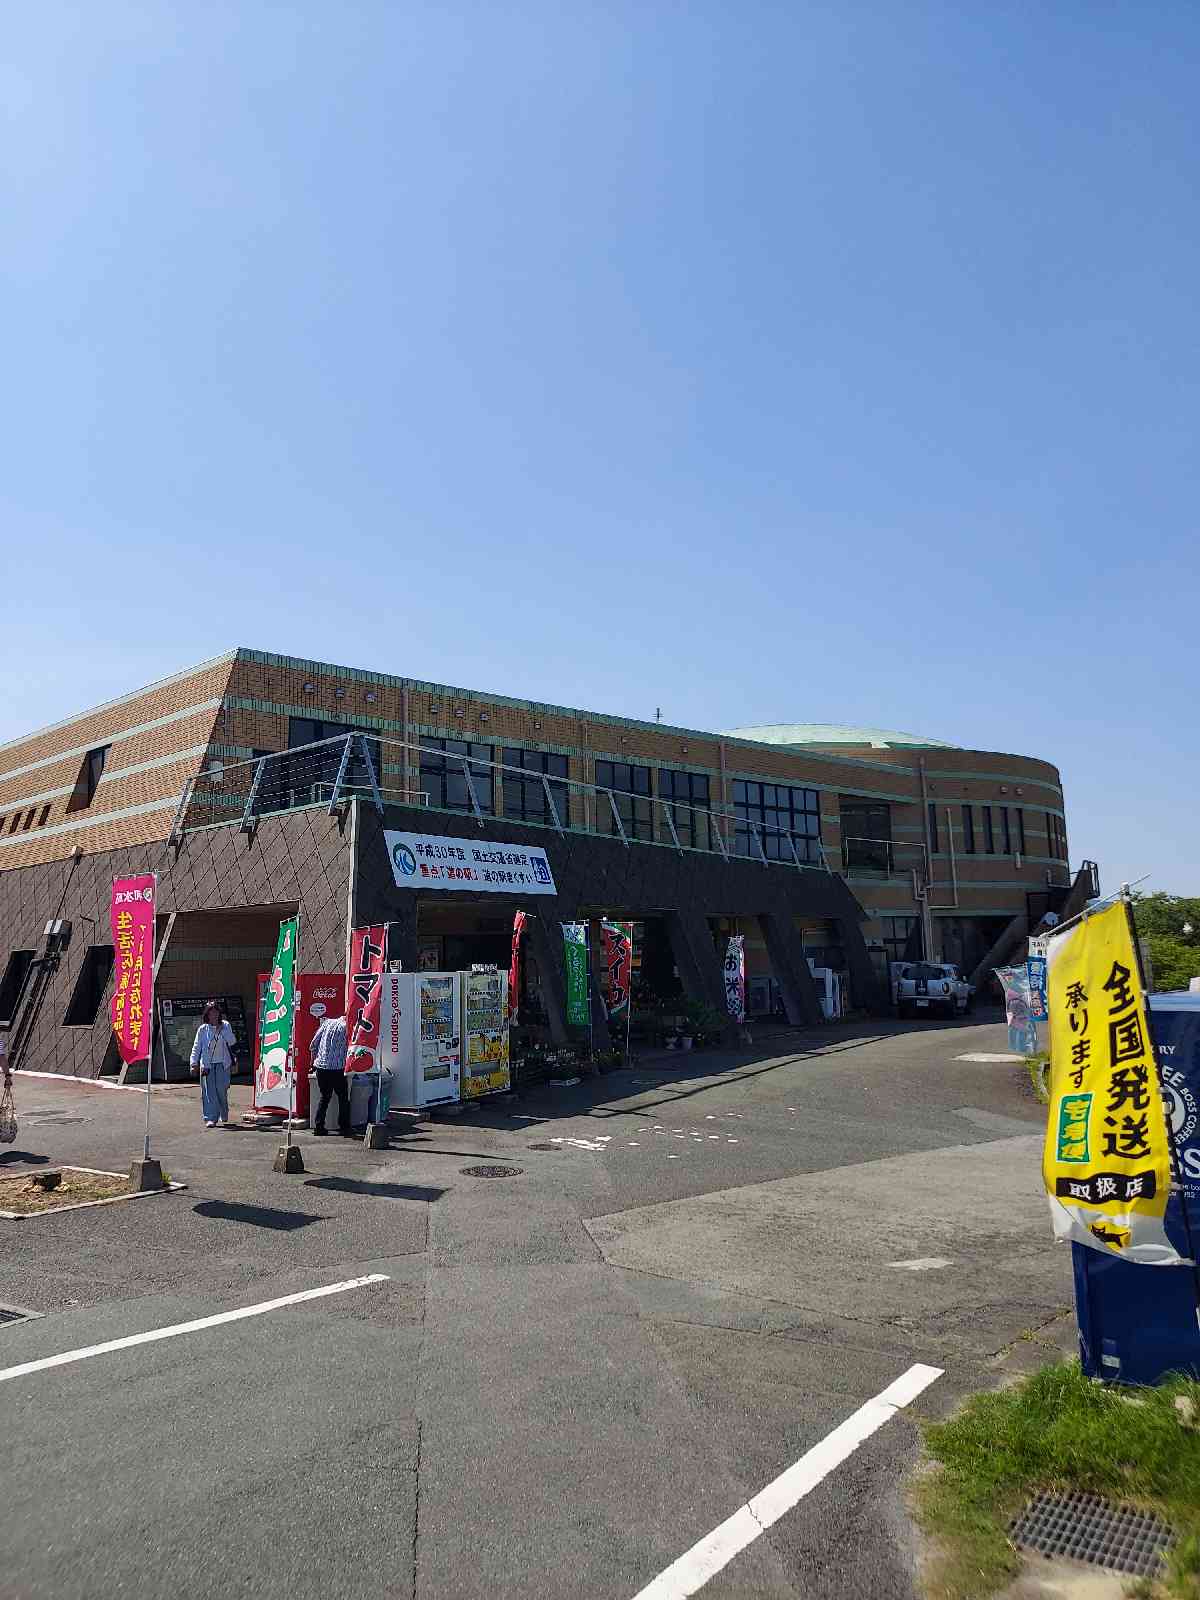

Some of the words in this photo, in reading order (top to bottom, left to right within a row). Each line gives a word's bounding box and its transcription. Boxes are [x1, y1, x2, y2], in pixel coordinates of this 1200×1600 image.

[415, 843, 466, 860] 平成30年度
[472, 849, 530, 866] 国土交通省選定
[351, 935, 383, 1045] トマト
[608, 932, 626, 1005] スイカ
[1065, 981, 1091, 1088] 承ります
[1101, 960, 1151, 1160] 全国発送
[1180, 1087, 1198, 1113] BOSS
[1174, 1115, 1197, 1145] COFFEE
[1069, 1177, 1144, 1200] 取扱店
